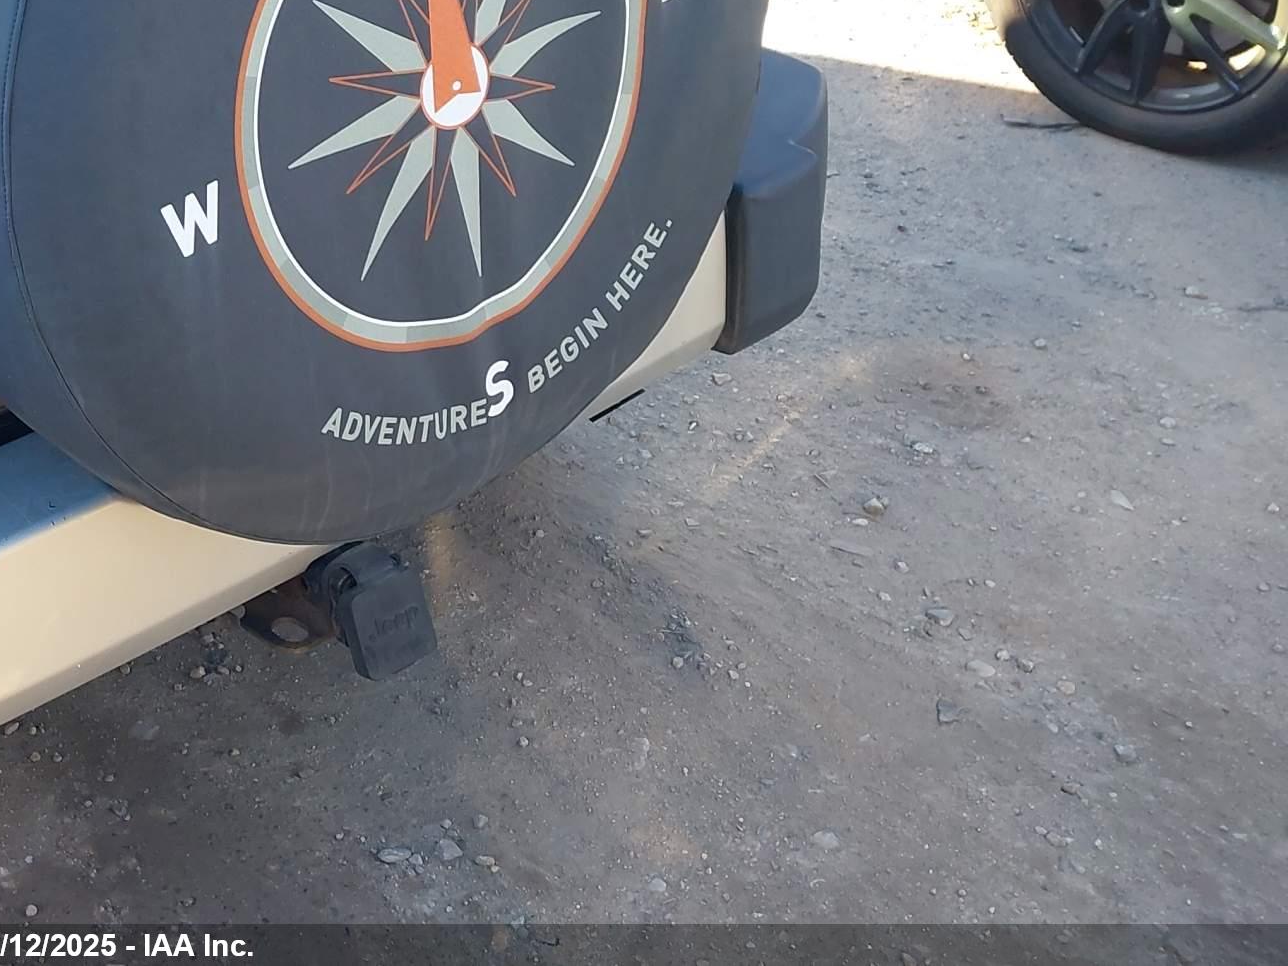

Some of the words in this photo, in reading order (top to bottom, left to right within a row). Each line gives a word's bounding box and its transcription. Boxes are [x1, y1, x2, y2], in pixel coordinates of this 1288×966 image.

[160, 180, 219, 257] W
[321, 360, 514, 445] ADVENTURES
[527, 308, 609, 394] BEGIN
[605, 218, 673, 312] HERE.
[368, 605, 420, 642] Jeep
